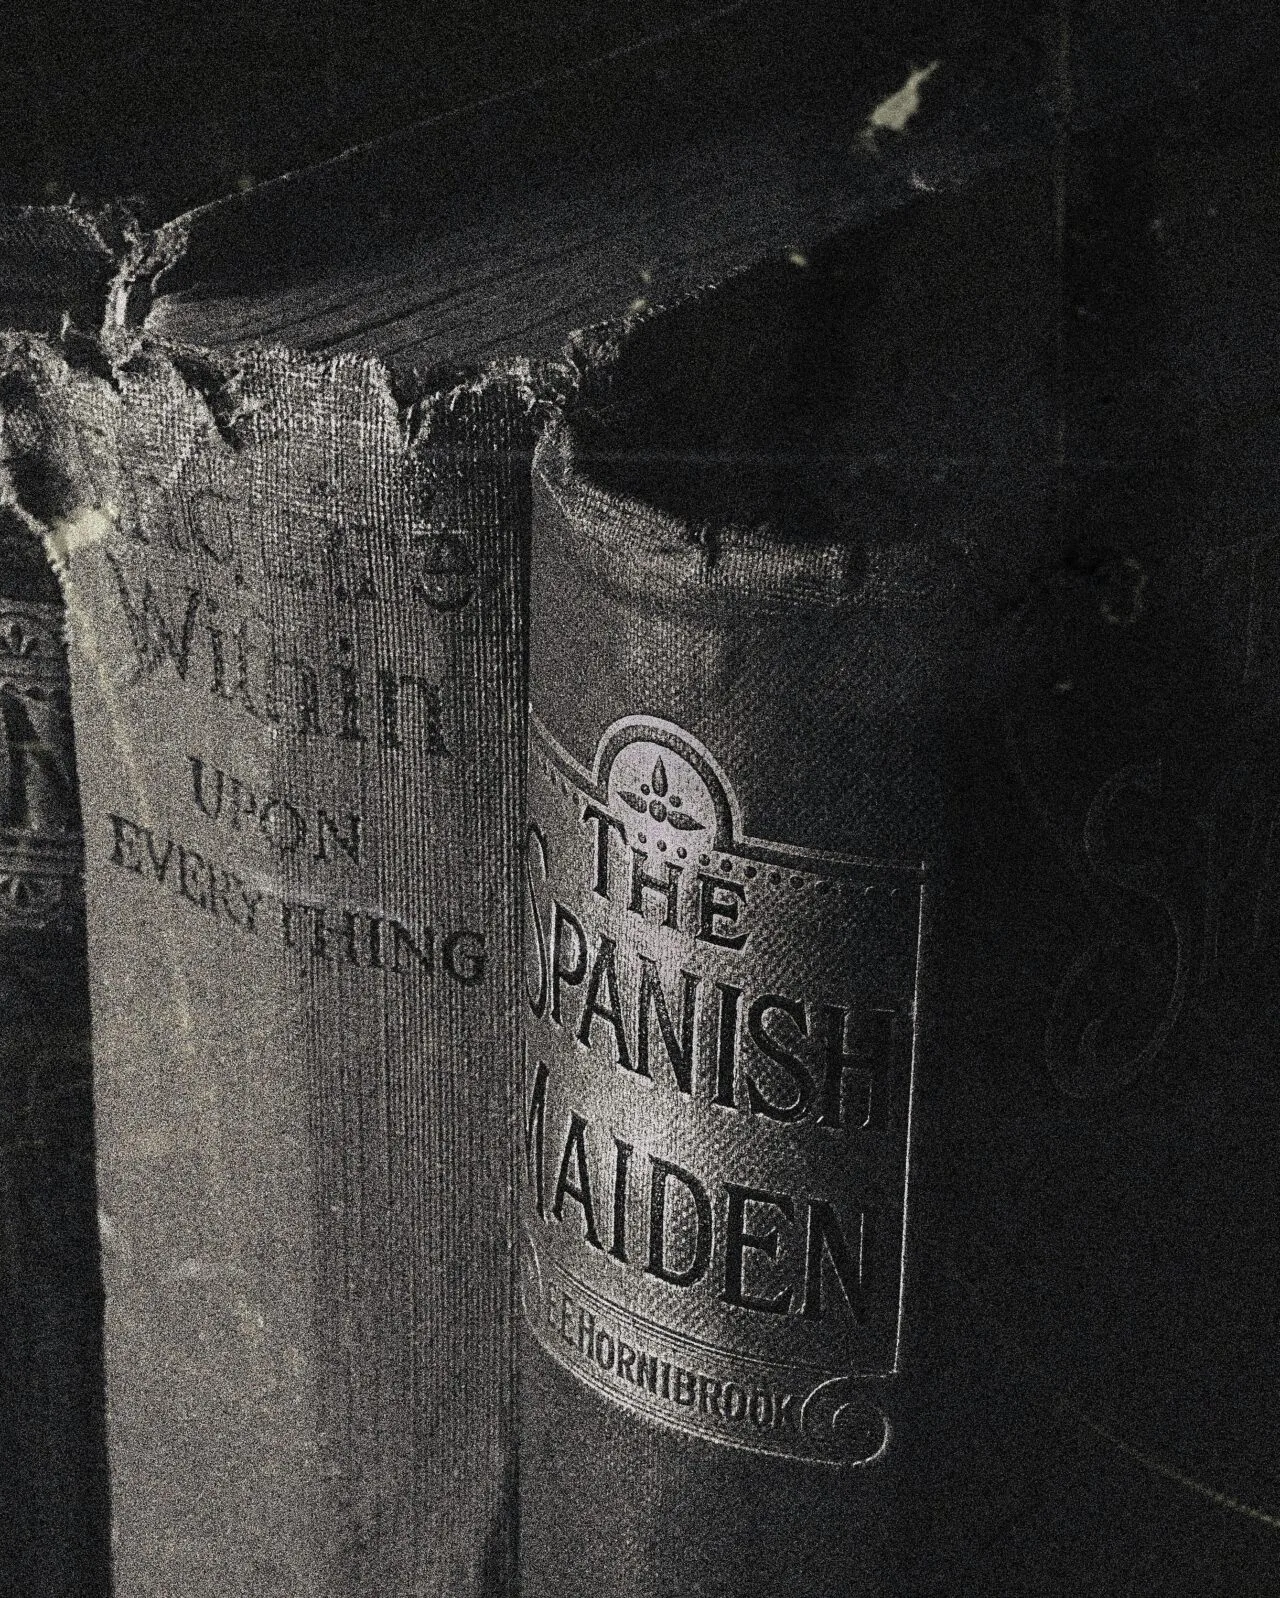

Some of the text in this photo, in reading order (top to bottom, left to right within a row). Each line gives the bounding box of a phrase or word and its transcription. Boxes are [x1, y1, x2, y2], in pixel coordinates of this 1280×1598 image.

[188, 755, 363, 867] UPON
[583, 804, 749, 951] THE
[108, 811, 489, 989] EVERYTHING
